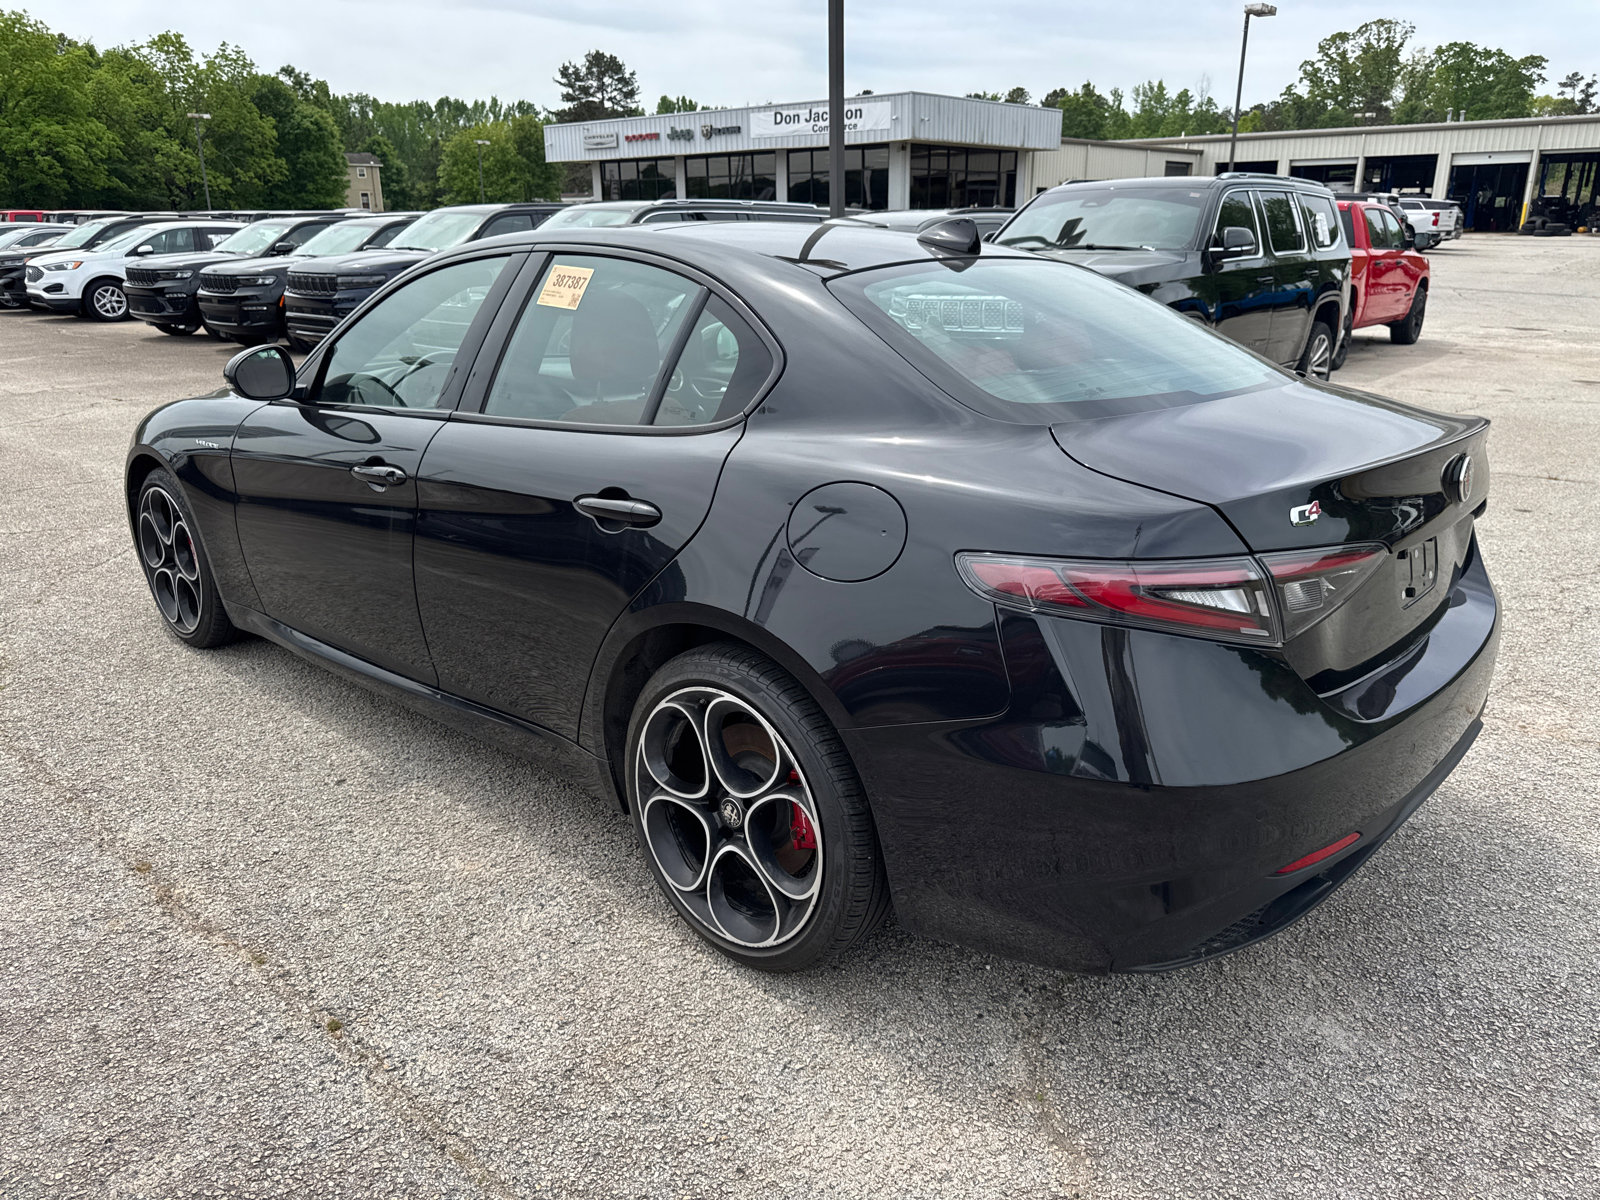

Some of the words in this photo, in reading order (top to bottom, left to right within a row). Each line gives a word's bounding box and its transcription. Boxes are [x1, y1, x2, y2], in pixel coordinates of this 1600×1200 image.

[774, 111, 800, 125] Don
[805, 108, 862, 123] Jacon
[667, 126, 694, 141] Jeep
[812, 123, 858, 133] Comrce
[624, 132, 660, 142] DODGE
[553, 274, 587, 290] 387387
[1290, 500, 1321, 526] Q4
